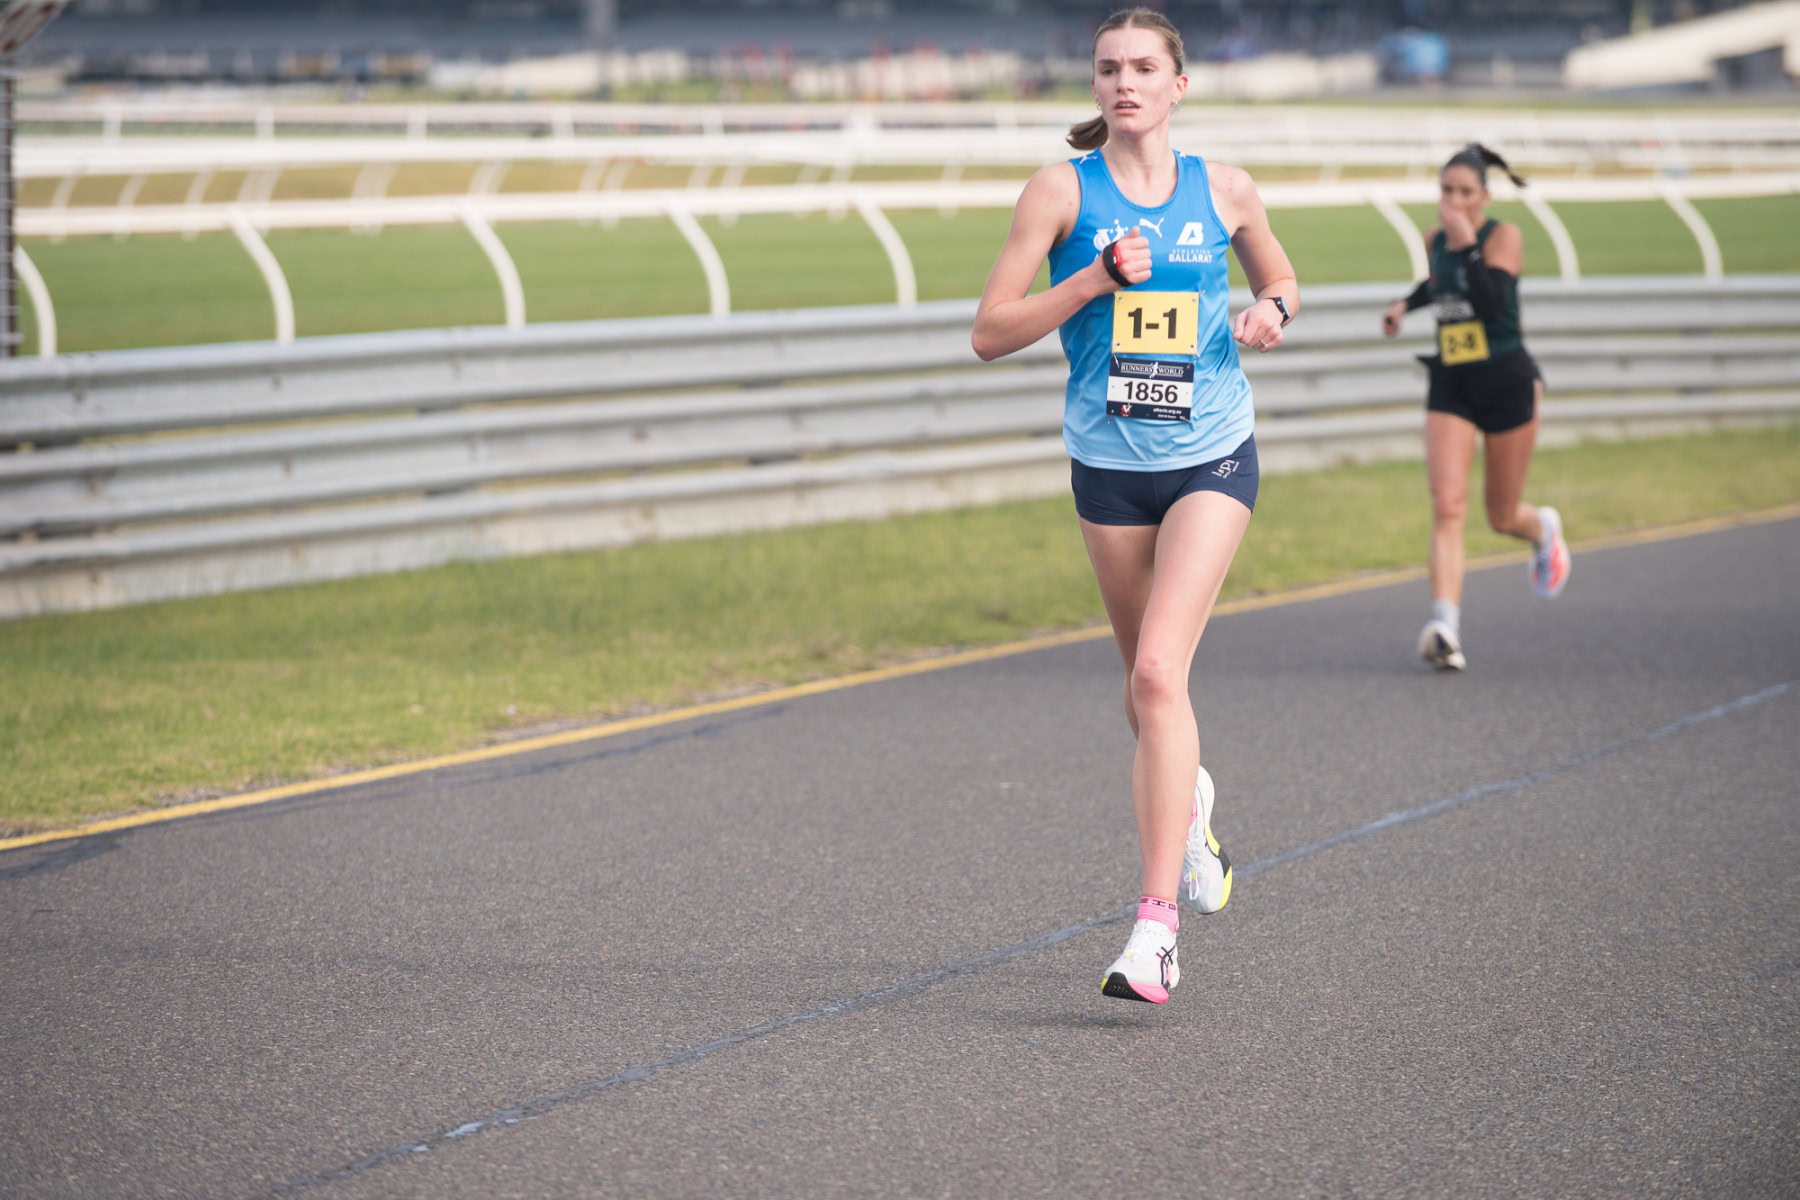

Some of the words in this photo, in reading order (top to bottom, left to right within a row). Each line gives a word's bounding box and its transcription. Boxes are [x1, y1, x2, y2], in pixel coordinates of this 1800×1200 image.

[1168, 253, 1213, 263] BALLARAT
[1128, 307, 1177, 339] 1-1
[1158, 367, 1184, 376] WORLD
[1124, 381, 1178, 404] 1856
